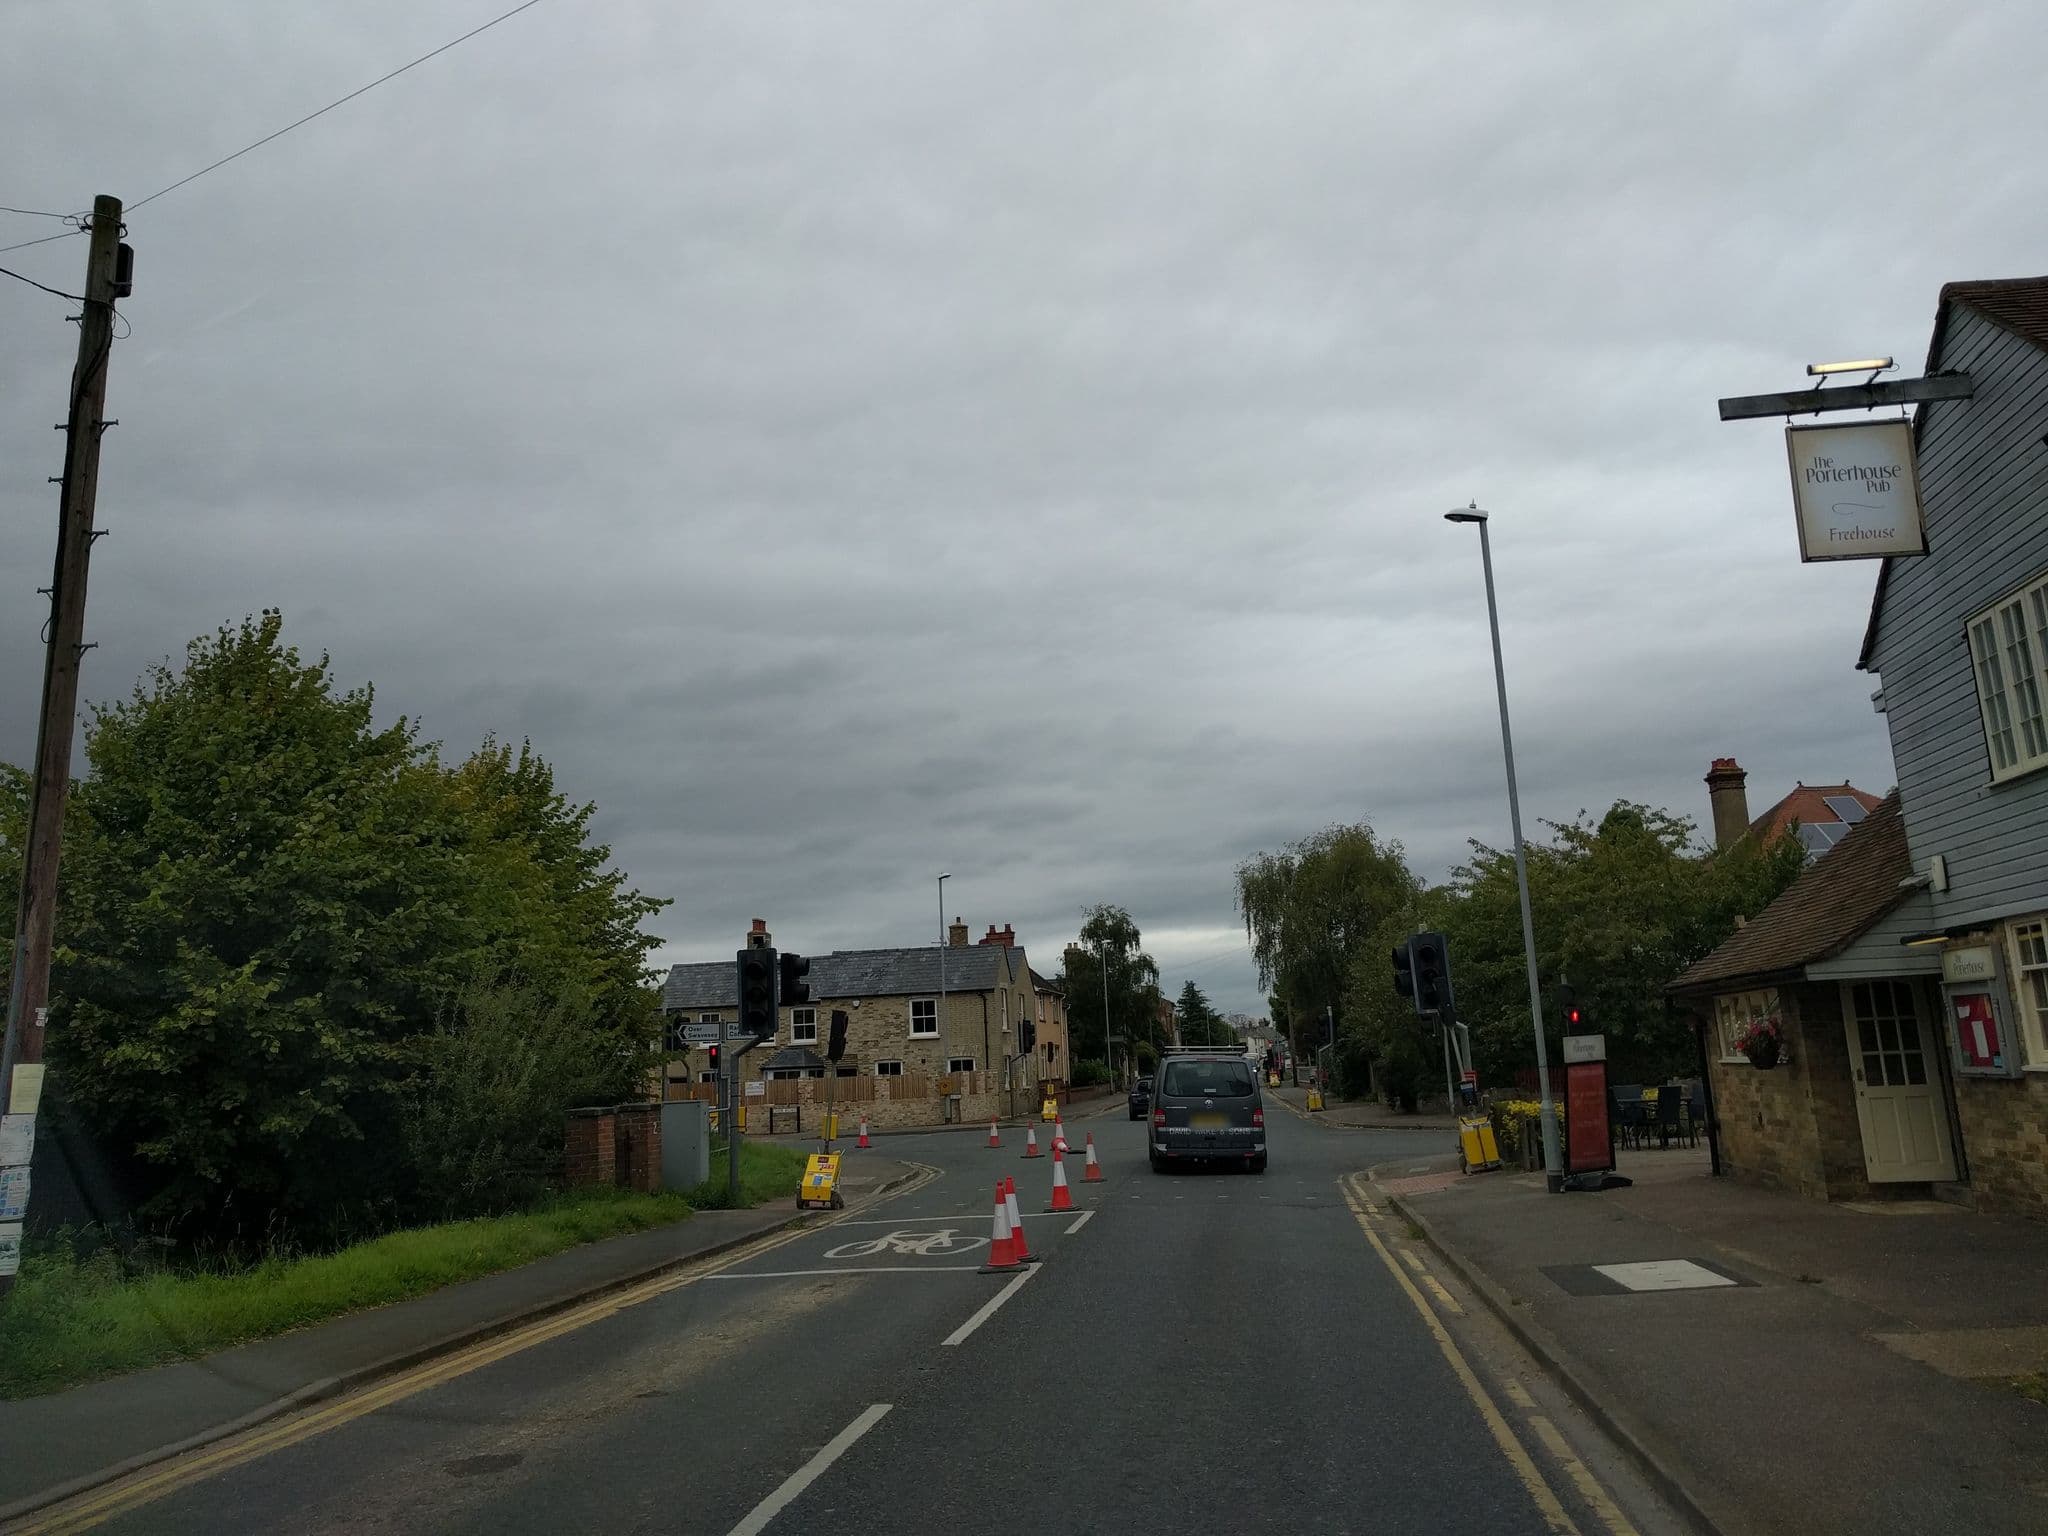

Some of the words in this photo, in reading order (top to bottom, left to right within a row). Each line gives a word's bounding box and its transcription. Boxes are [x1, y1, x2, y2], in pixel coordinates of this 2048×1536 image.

[1814, 456, 1834, 469] The
[1806, 465, 1901, 483] Porterhouse
[1866, 480, 1891, 493] Pub
[1829, 525, 1896, 542] Freehouse
[1169, 1127, 1192, 1136] DAVID
[1228, 1127, 1251, 1135] SONS
